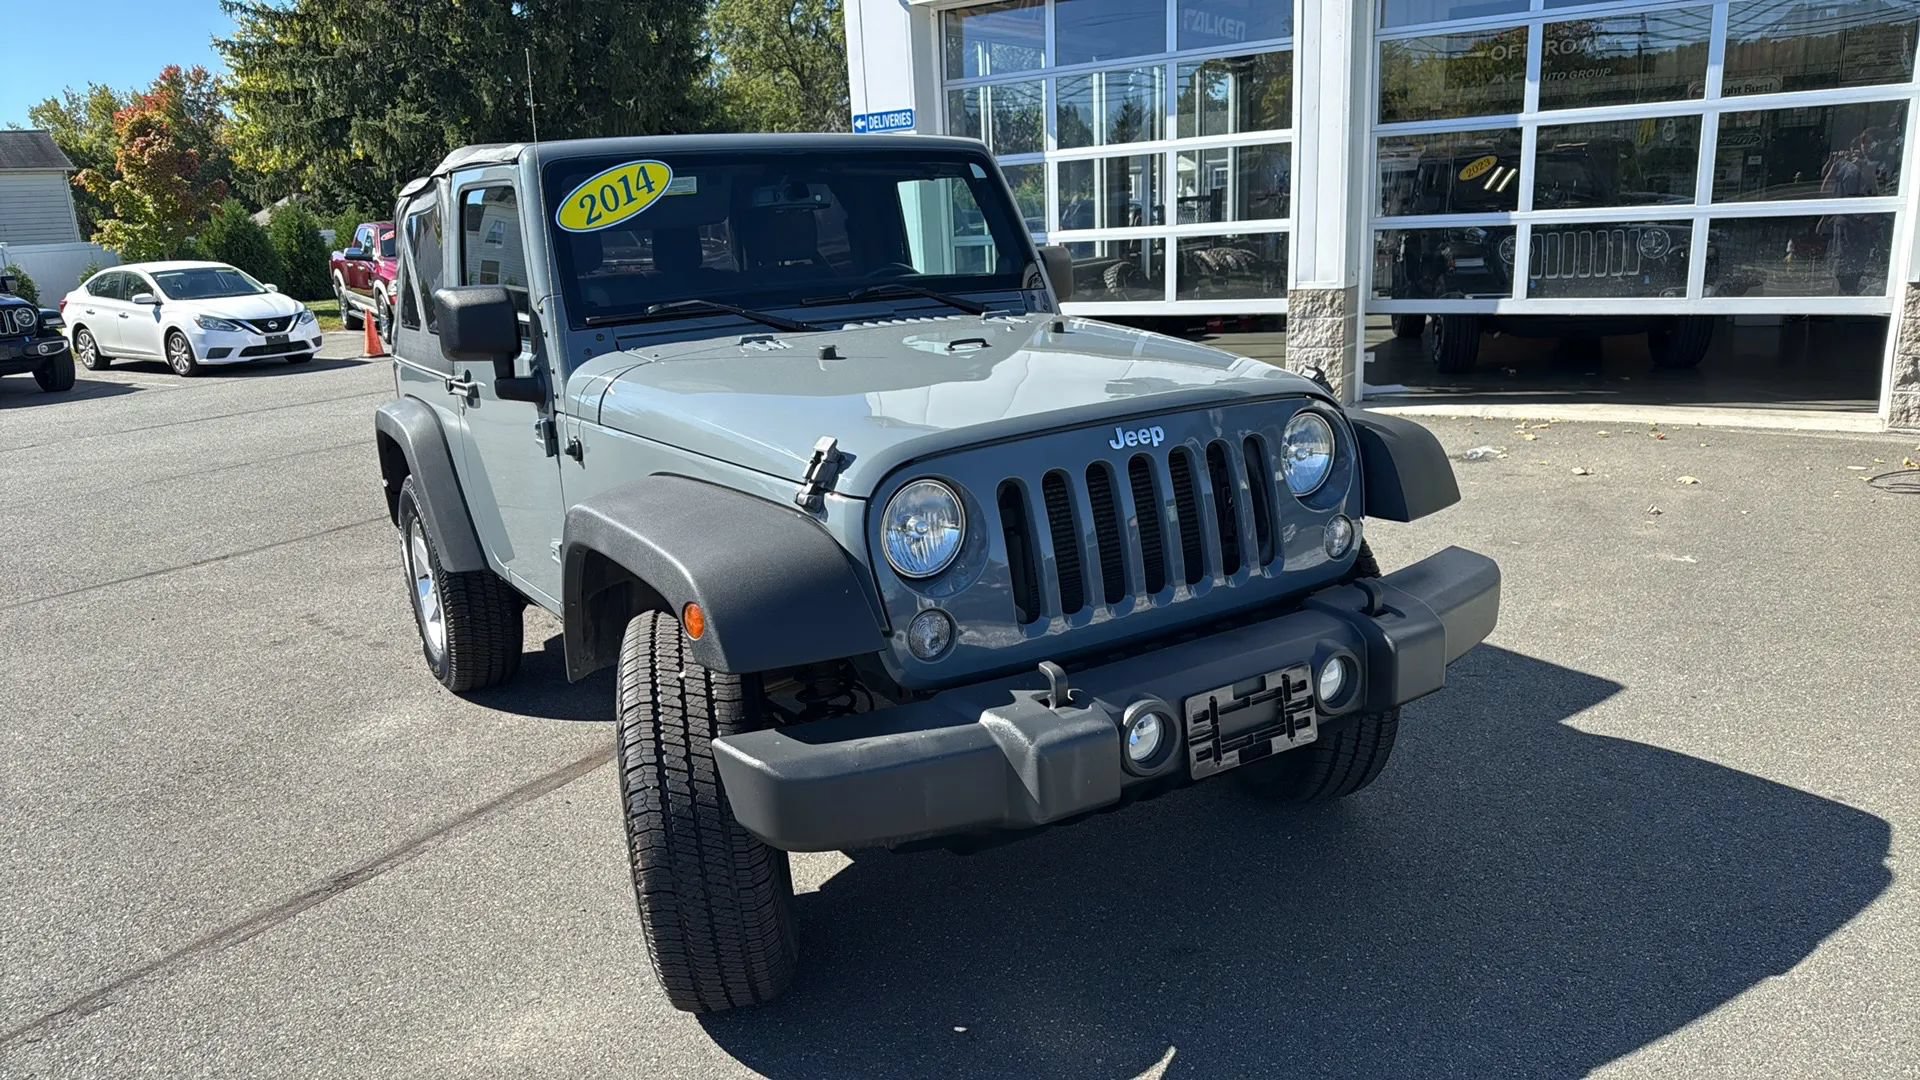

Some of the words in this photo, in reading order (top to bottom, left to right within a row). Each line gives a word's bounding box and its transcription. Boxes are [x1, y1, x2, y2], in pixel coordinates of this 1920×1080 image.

[1490, 43, 1528, 61] OF
[1542, 72, 1566, 81] UTO
[1568, 67, 1612, 81] GROUP
[1723, 86, 1741, 96] ght
[868, 112, 912, 129] DELIVERIES
[1465, 158, 1492, 178] 2023
[579, 165, 656, 226] 2014
[1109, 426, 1165, 450] Jeep
